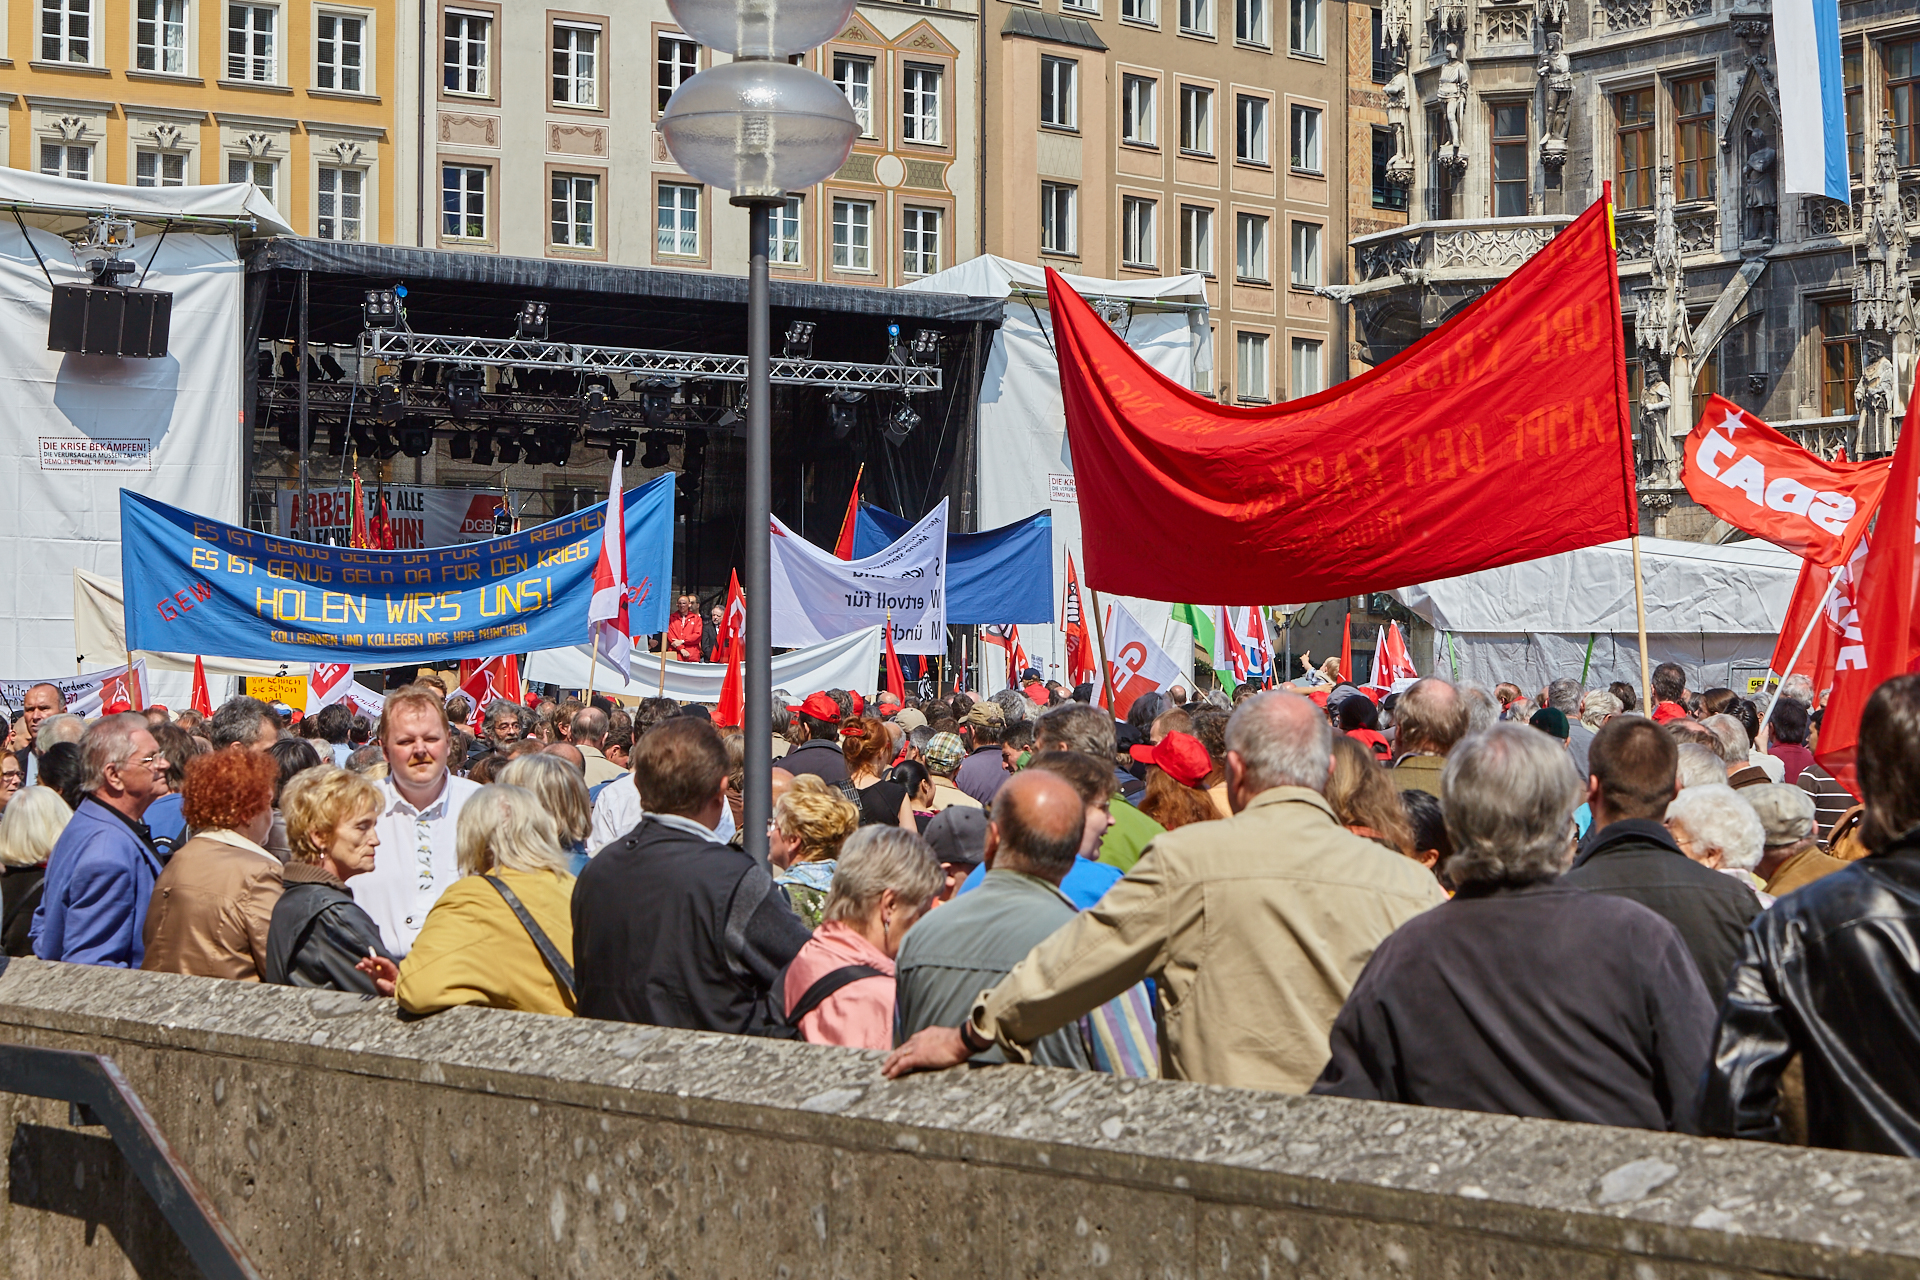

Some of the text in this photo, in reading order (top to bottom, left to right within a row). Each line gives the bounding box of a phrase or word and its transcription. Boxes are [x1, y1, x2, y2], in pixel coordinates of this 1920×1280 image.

[43, 441, 146, 452] DIE KRISE BEKÄMPFEN!
[54, 451, 97, 459] VERURSACHER
[98, 451, 121, 459] MÜSSEN
[1051, 477, 1062, 486] DIE
[290, 491, 424, 528] ARBEI FR ALLE
[465, 518, 493, 532] DGB
[194, 521, 219, 541] ES
[227, 529, 255, 547] IST
[265, 539, 329, 560] GENUG
[191, 539, 589, 584] ES IST GENUG GELD DA FÜR DEN KRIEG
[156, 581, 211, 622] GEW
[256, 577, 552, 624] HOLEN WIR'S UNS!
[271, 622, 528, 647] KOLLEGINNEN UND KOLLEGEN DES HPA MÜNCHEN
